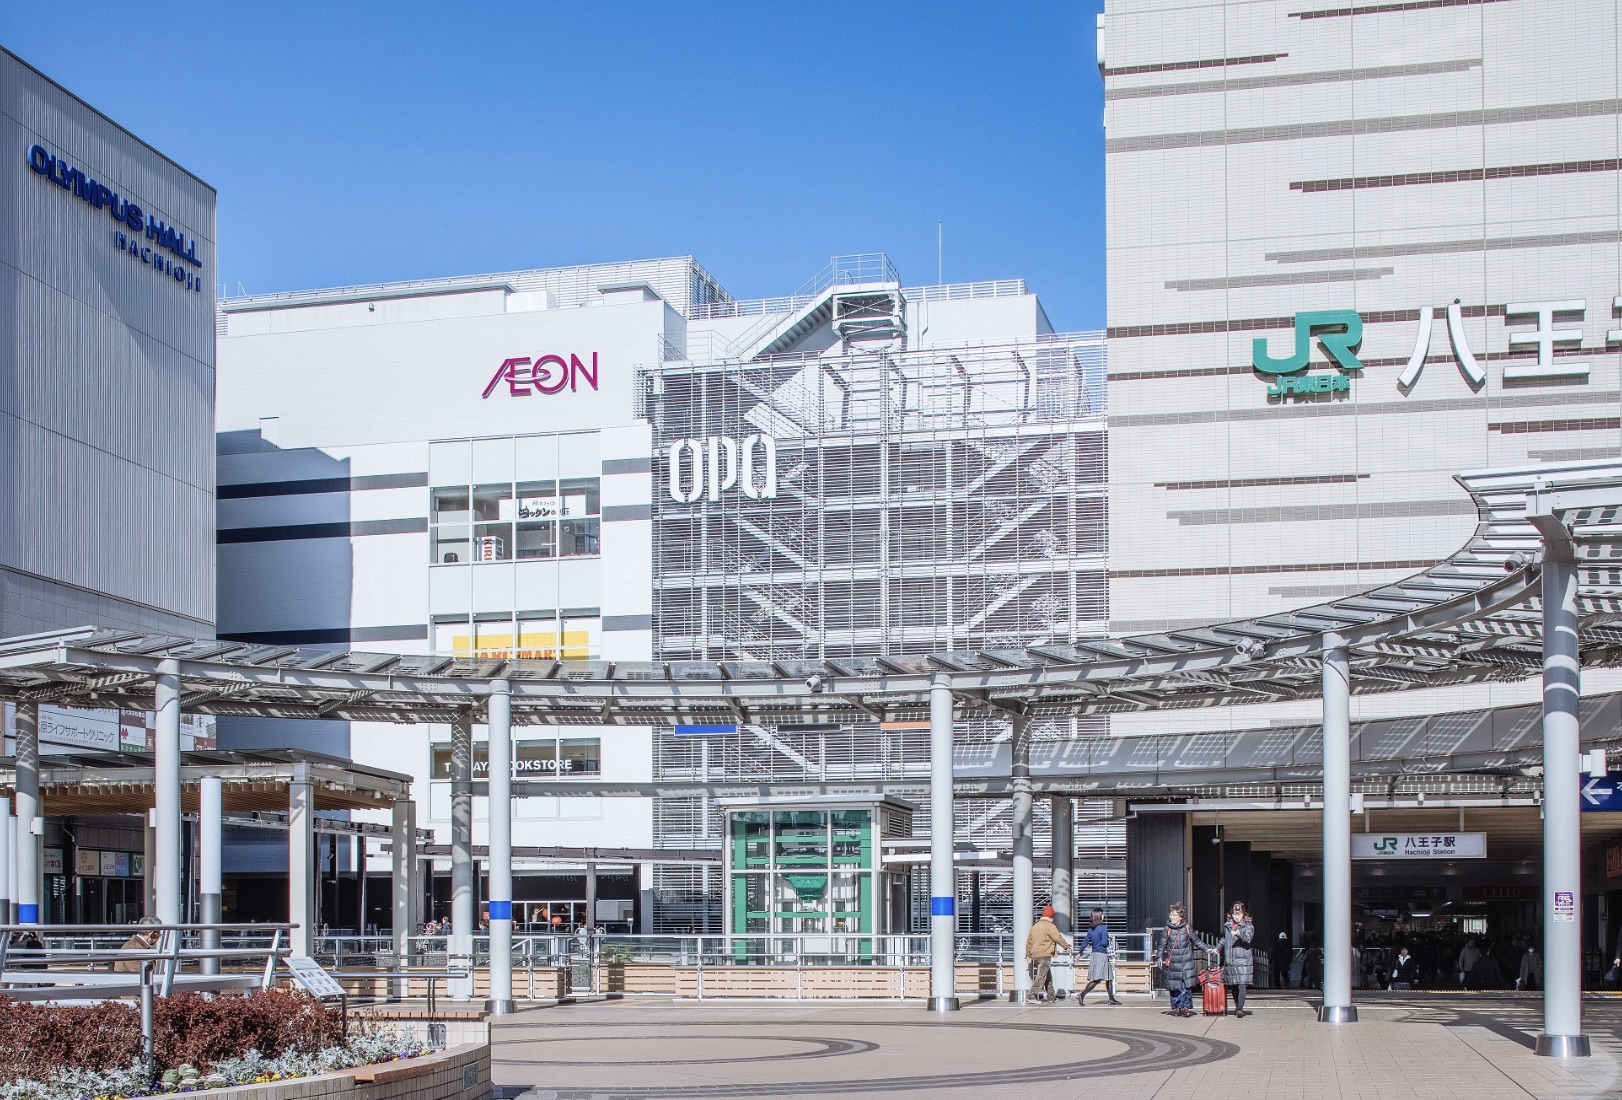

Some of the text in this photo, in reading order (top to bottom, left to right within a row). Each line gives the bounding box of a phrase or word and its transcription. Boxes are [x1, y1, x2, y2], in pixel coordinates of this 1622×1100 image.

[27, 144, 202, 268] OLYMPUS HALL
[115, 230, 200, 292] HACHIOJI
[1252, 296, 1622, 388] JR 八王
[1267, 373, 1350, 395] JR東日本
[1373, 836, 1456, 850] JR 八王子駅
